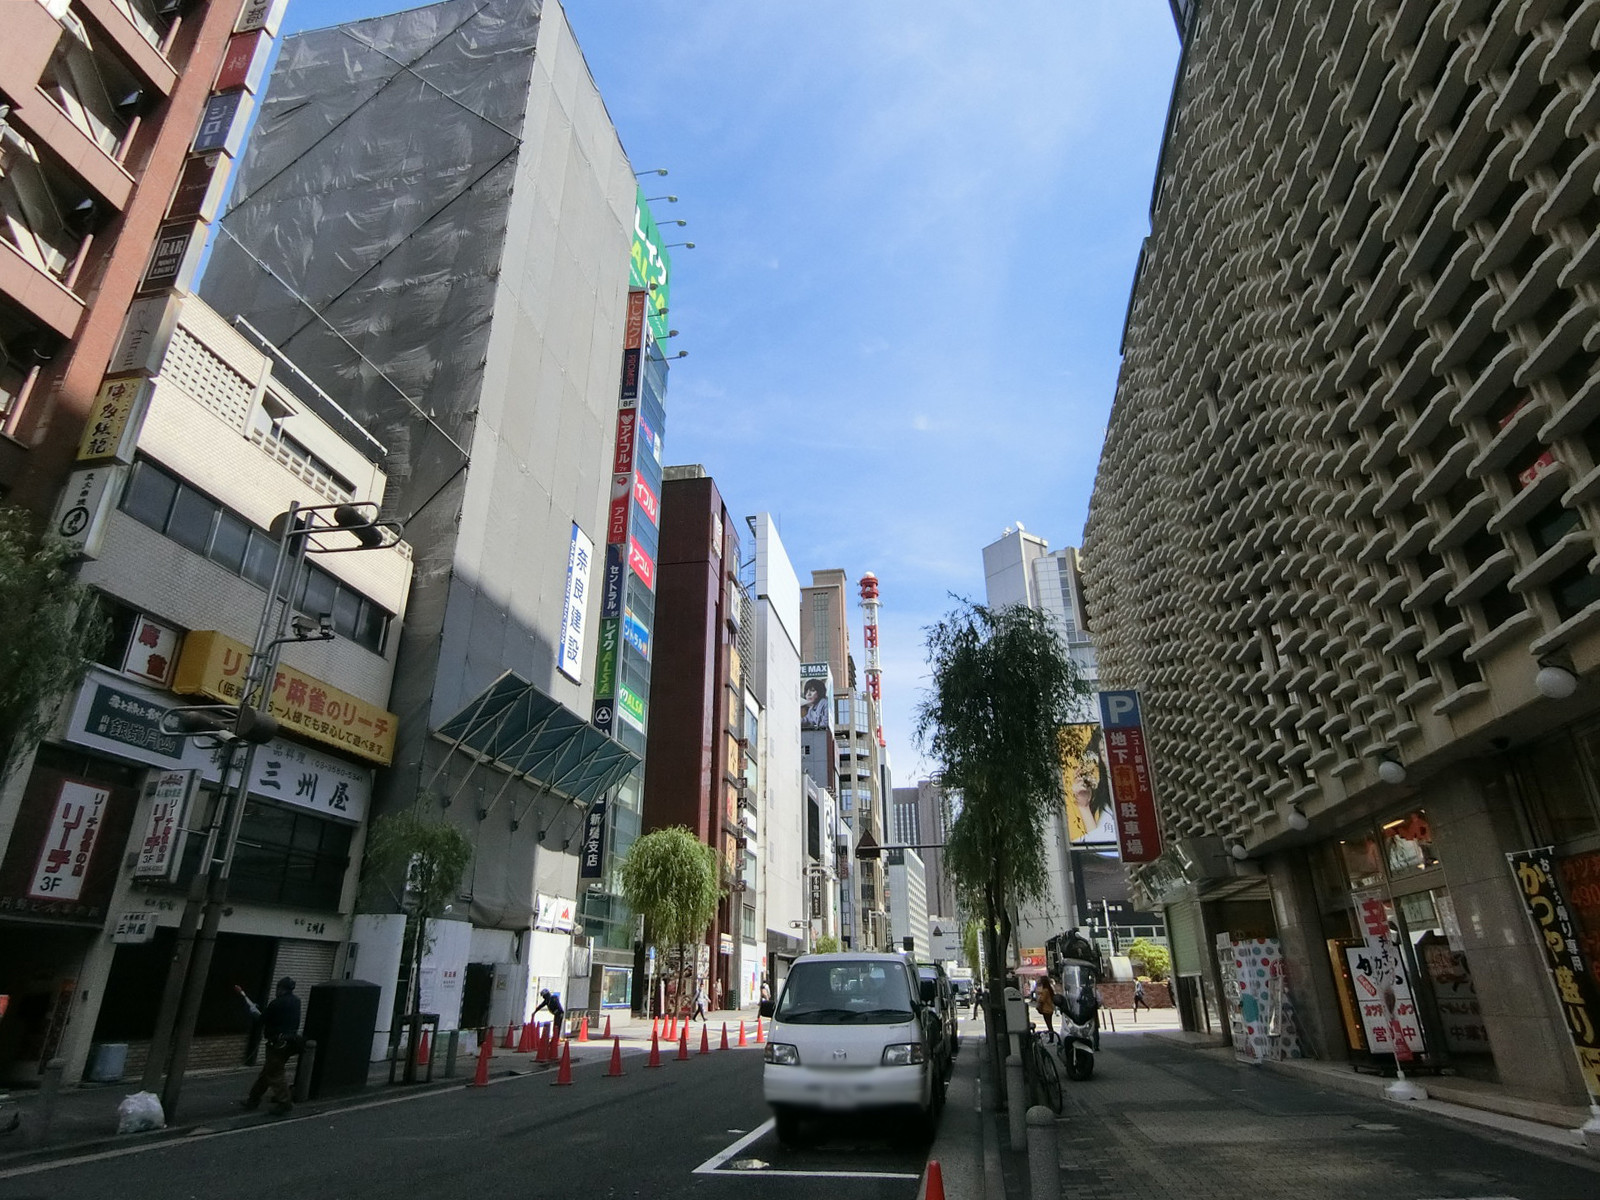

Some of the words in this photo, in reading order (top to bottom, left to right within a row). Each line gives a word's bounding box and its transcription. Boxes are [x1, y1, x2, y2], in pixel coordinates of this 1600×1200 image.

[625, 354, 637, 387] PROMISE
[618, 425, 632, 464] アイフル
[613, 506, 625, 534] アコム
[568, 539, 576, 567] NARA
[634, 548, 650, 577] アコム
[606, 564, 620, 610] セントラル
[566, 546, 589, 664] 奈良建設
[808, 665, 827, 673] MAX
[223, 648, 388, 738] リチ麻雀のリーチ
[1107, 695, 1135, 724] P
[259, 760, 350, 812] 三州屋
[46, 802, 84, 874] リーチ
[143, 803, 168, 854] リーチ
[586, 812, 603, 867] 新橋支店
[142, 854, 154, 864] 3F
[39, 876, 63, 892] 3F
[116, 923, 147, 935] 三州屋
[1372, 1025, 1417, 1043] 営中
